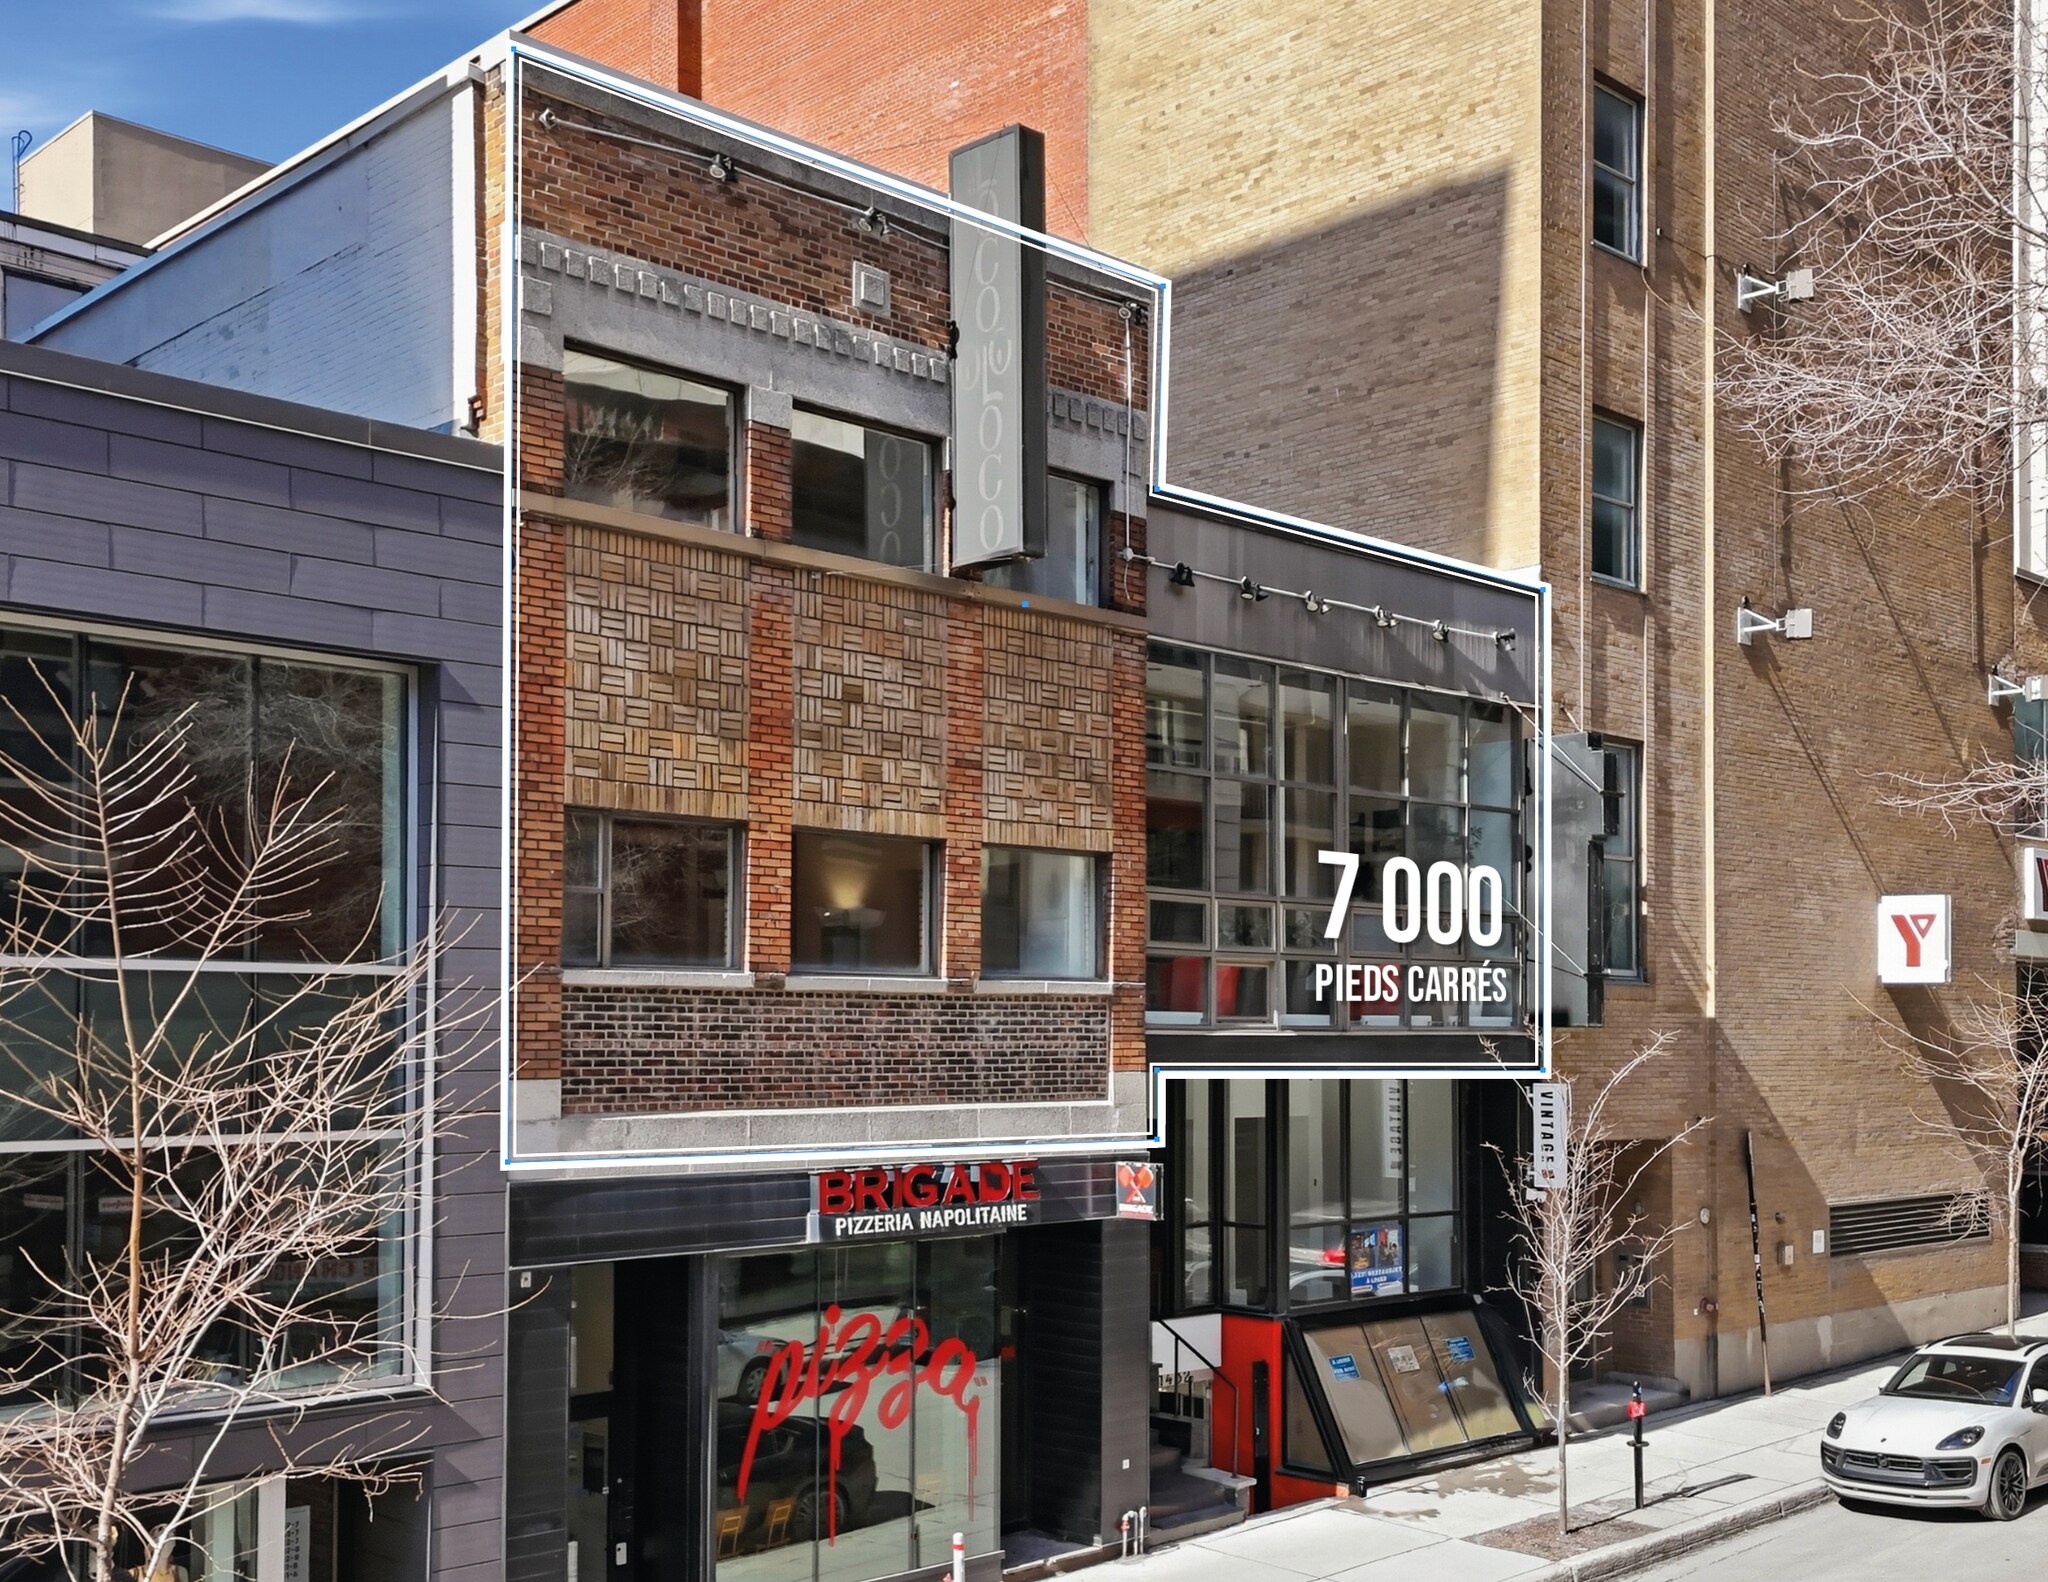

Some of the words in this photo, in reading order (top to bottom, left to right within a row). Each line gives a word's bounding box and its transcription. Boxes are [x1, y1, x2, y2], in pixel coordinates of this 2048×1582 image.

[1540, 1091, 1554, 1163] VINTAGE
[815, 1158, 1040, 1215] BRIGADE
[836, 1209, 914, 1236] PIZZERIA
[920, 1204, 1028, 1230] NAPOLITAINE
[735, 1303, 981, 1547] pizza
